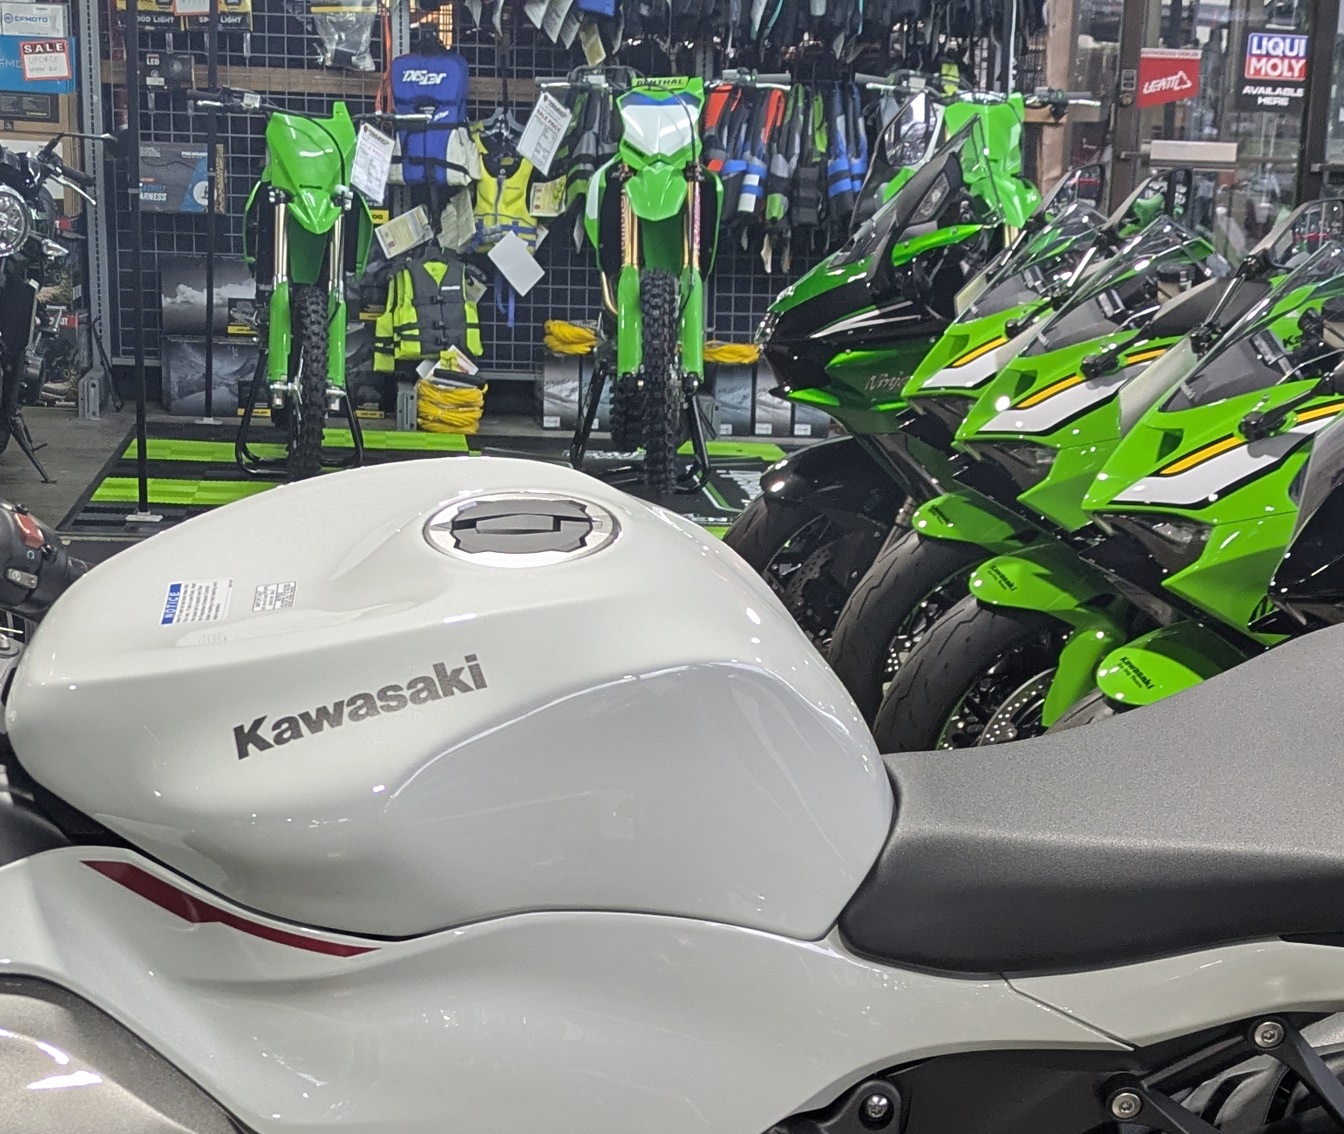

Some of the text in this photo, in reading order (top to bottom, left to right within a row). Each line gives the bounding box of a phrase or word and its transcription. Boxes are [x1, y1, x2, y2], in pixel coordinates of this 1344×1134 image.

[14, 15, 48, 23] CFMOTO
[153, 15, 175, 24] LIGHT
[220, 15, 242, 24] LIGHT
[23, 43, 63, 53] SALE
[1250, 36, 1306, 57] LIQUI
[1249, 58, 1306, 78] MOLY
[1242, 85, 1305, 97] AVAILABLE
[1257, 96, 1289, 107] HERE
[162, 586, 181, 622] NOTICE
[233, 653, 488, 760] Kawasaki
